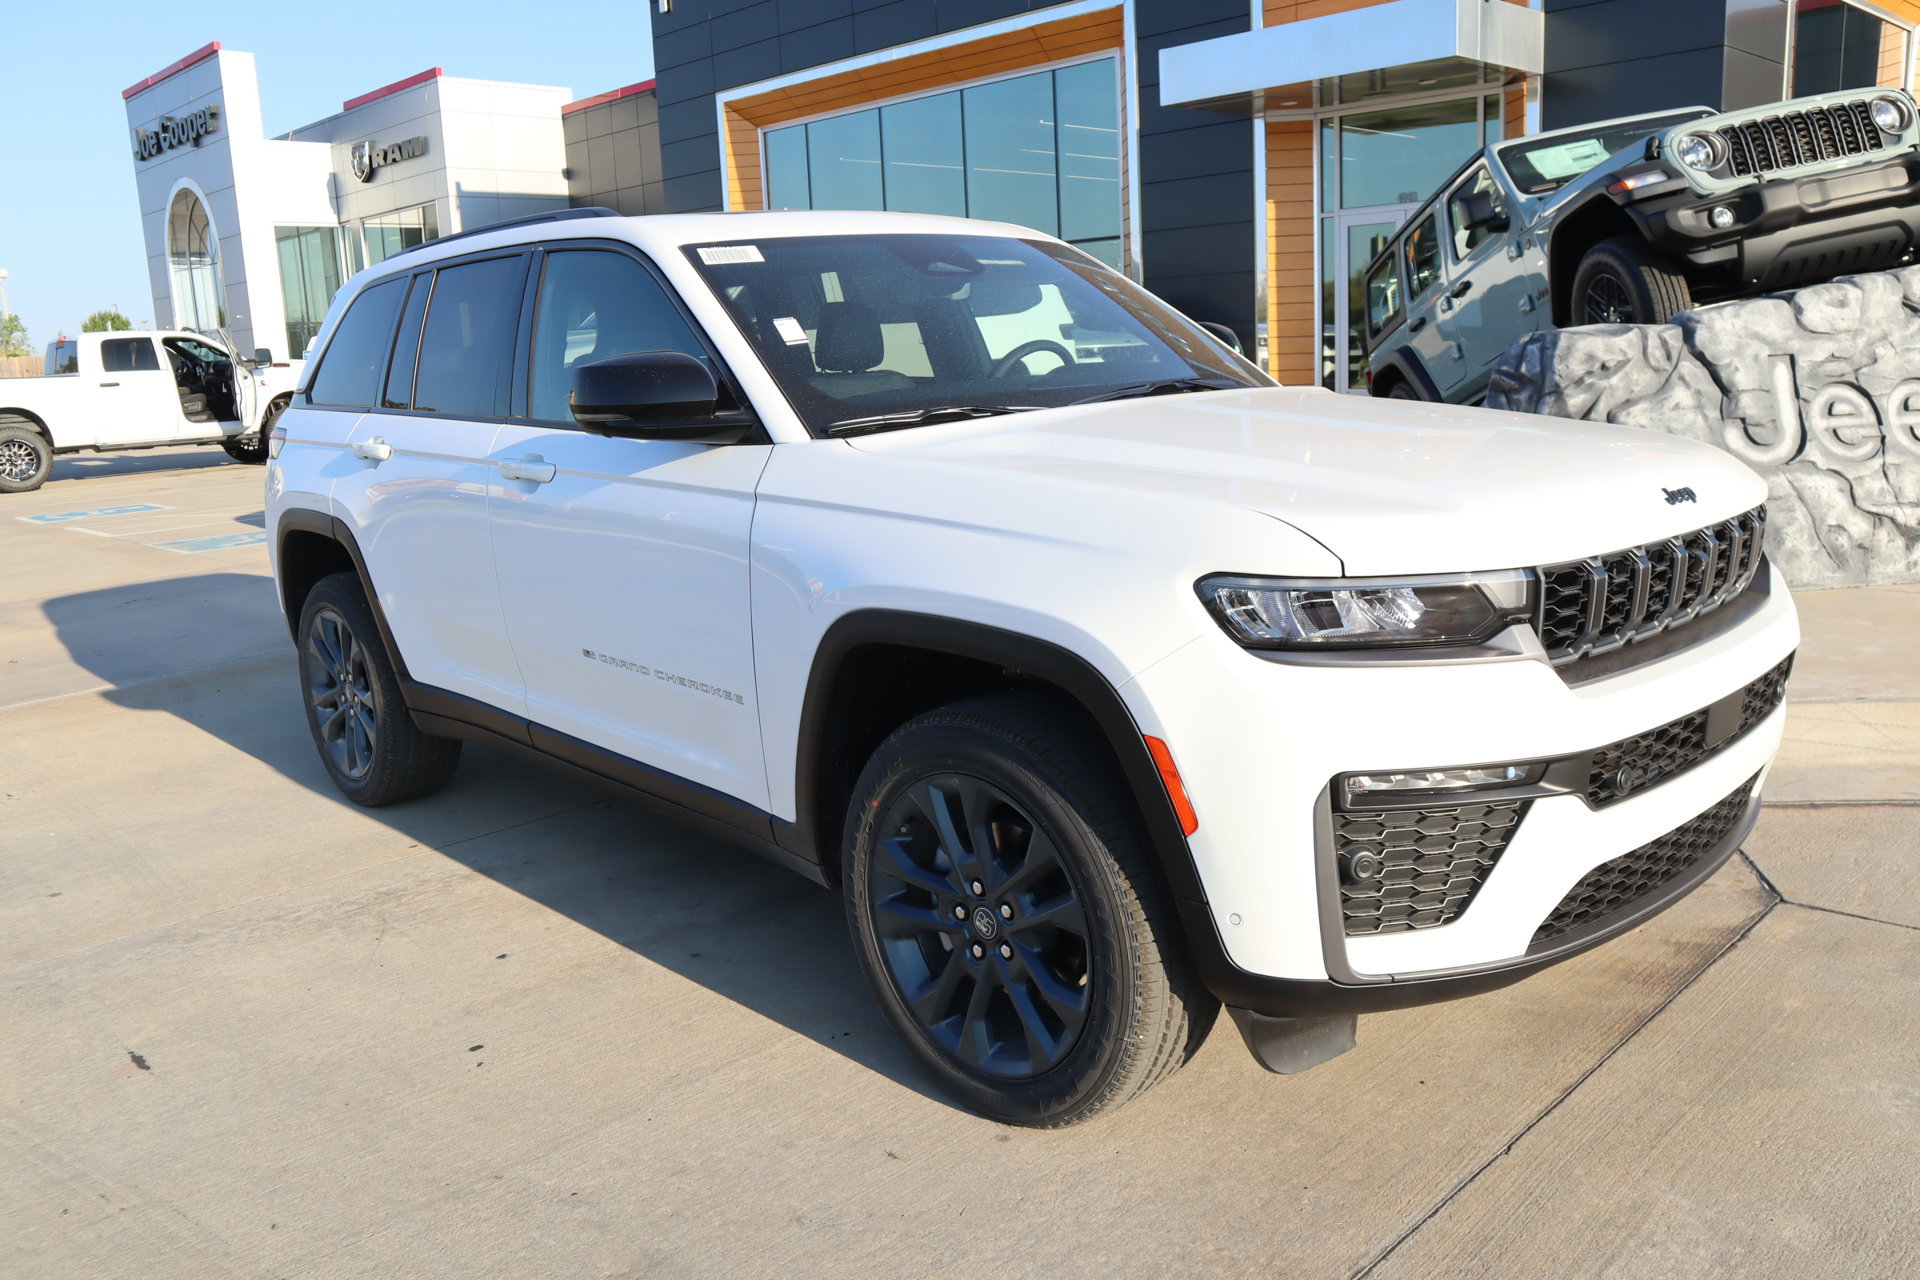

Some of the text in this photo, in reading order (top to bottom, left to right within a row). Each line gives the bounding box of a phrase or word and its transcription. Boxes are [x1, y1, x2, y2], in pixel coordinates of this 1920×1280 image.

[131, 105, 217, 161] Joe Cooper
[371, 136, 426, 168] RAM
[1661, 487, 1697, 505] Jeep
[599, 654, 744, 705] GRAND CHEROKEE
